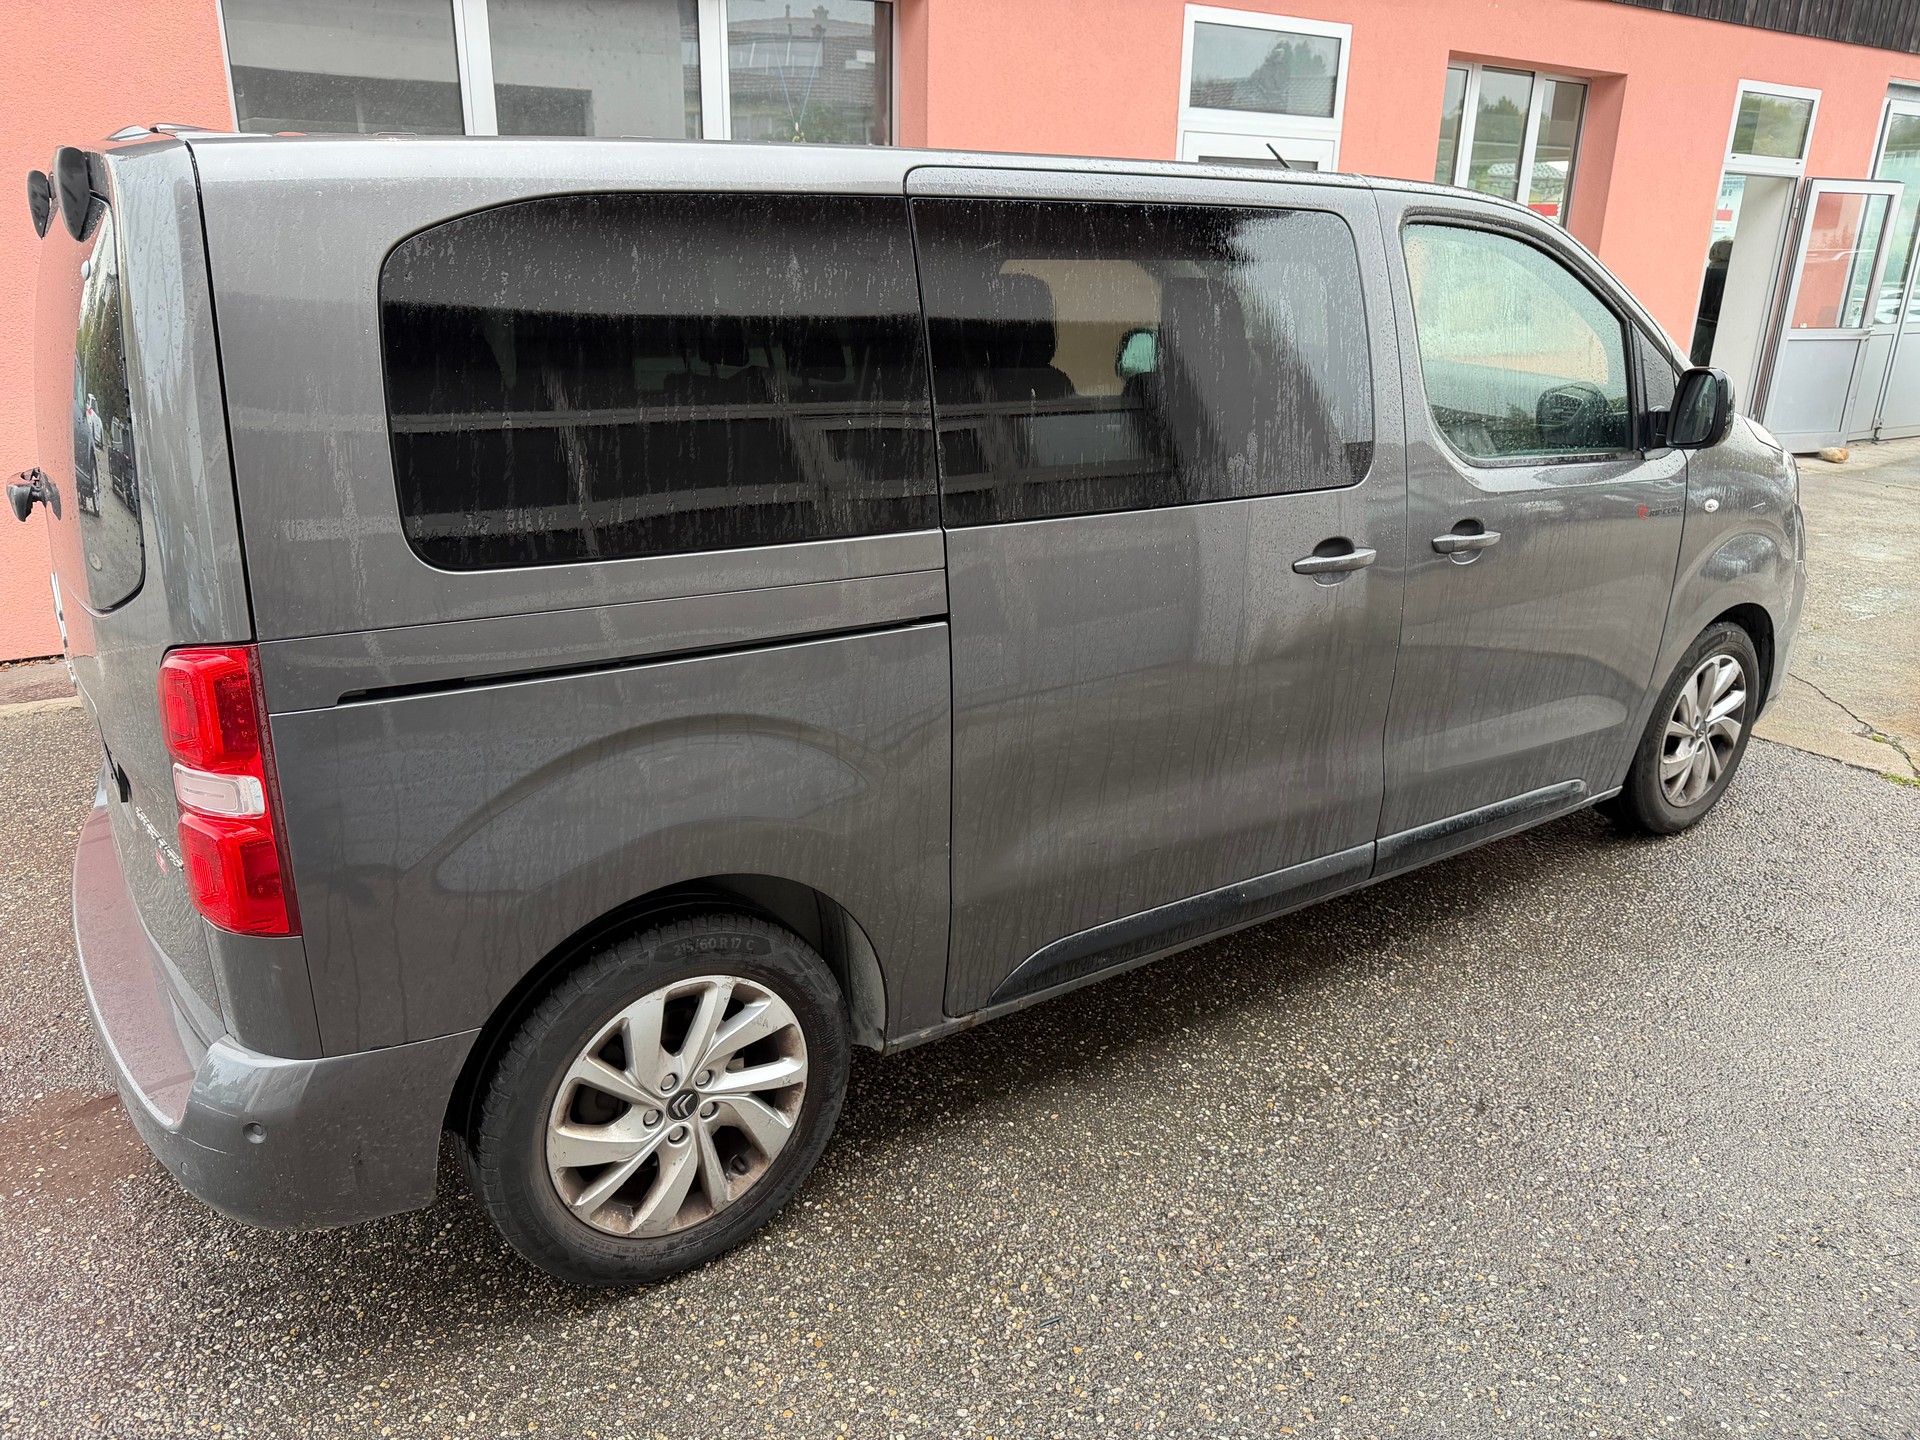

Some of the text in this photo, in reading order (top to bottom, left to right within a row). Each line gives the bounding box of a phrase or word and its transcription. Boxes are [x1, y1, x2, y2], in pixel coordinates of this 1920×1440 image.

[673, 937, 754, 957] 215/60 R 17 C
